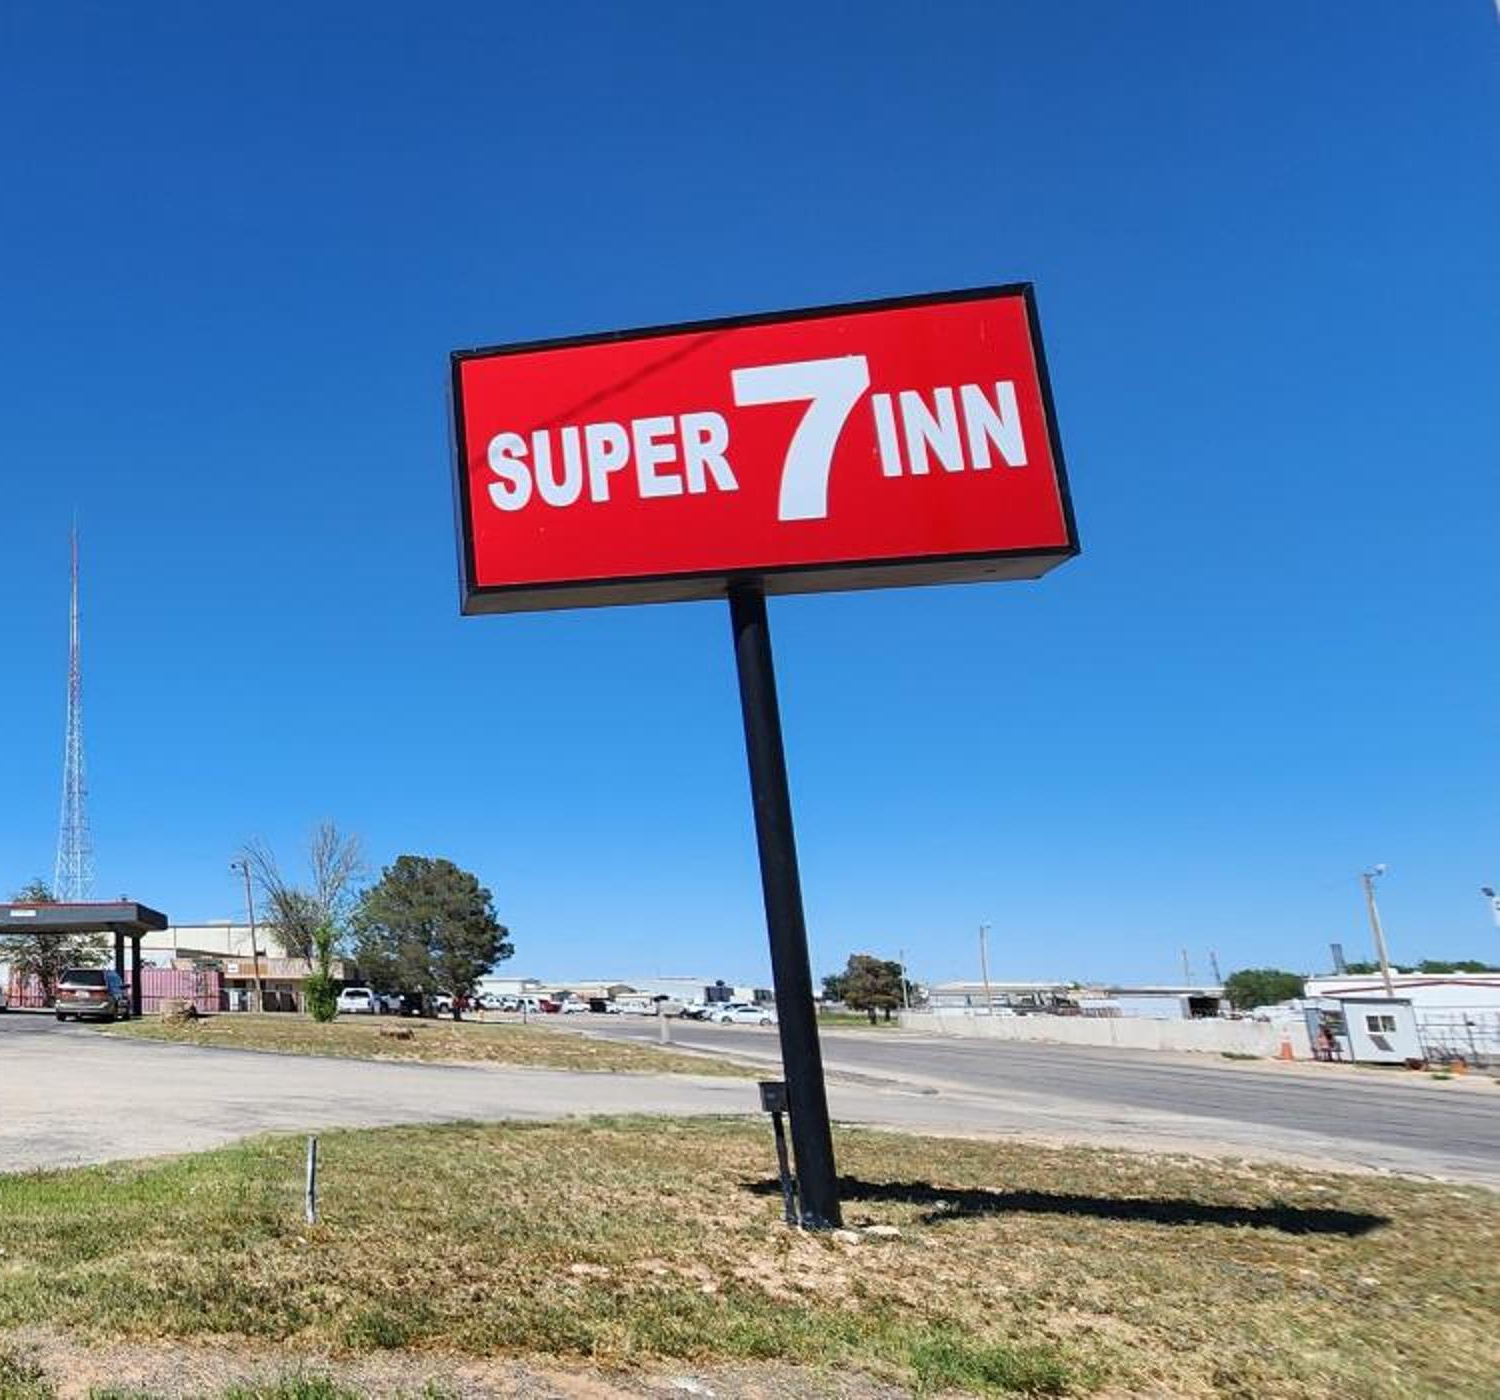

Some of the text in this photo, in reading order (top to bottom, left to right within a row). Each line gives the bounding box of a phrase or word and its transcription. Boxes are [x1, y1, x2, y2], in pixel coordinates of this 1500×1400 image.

[487, 354, 1028, 521] SUPER 7 INN
